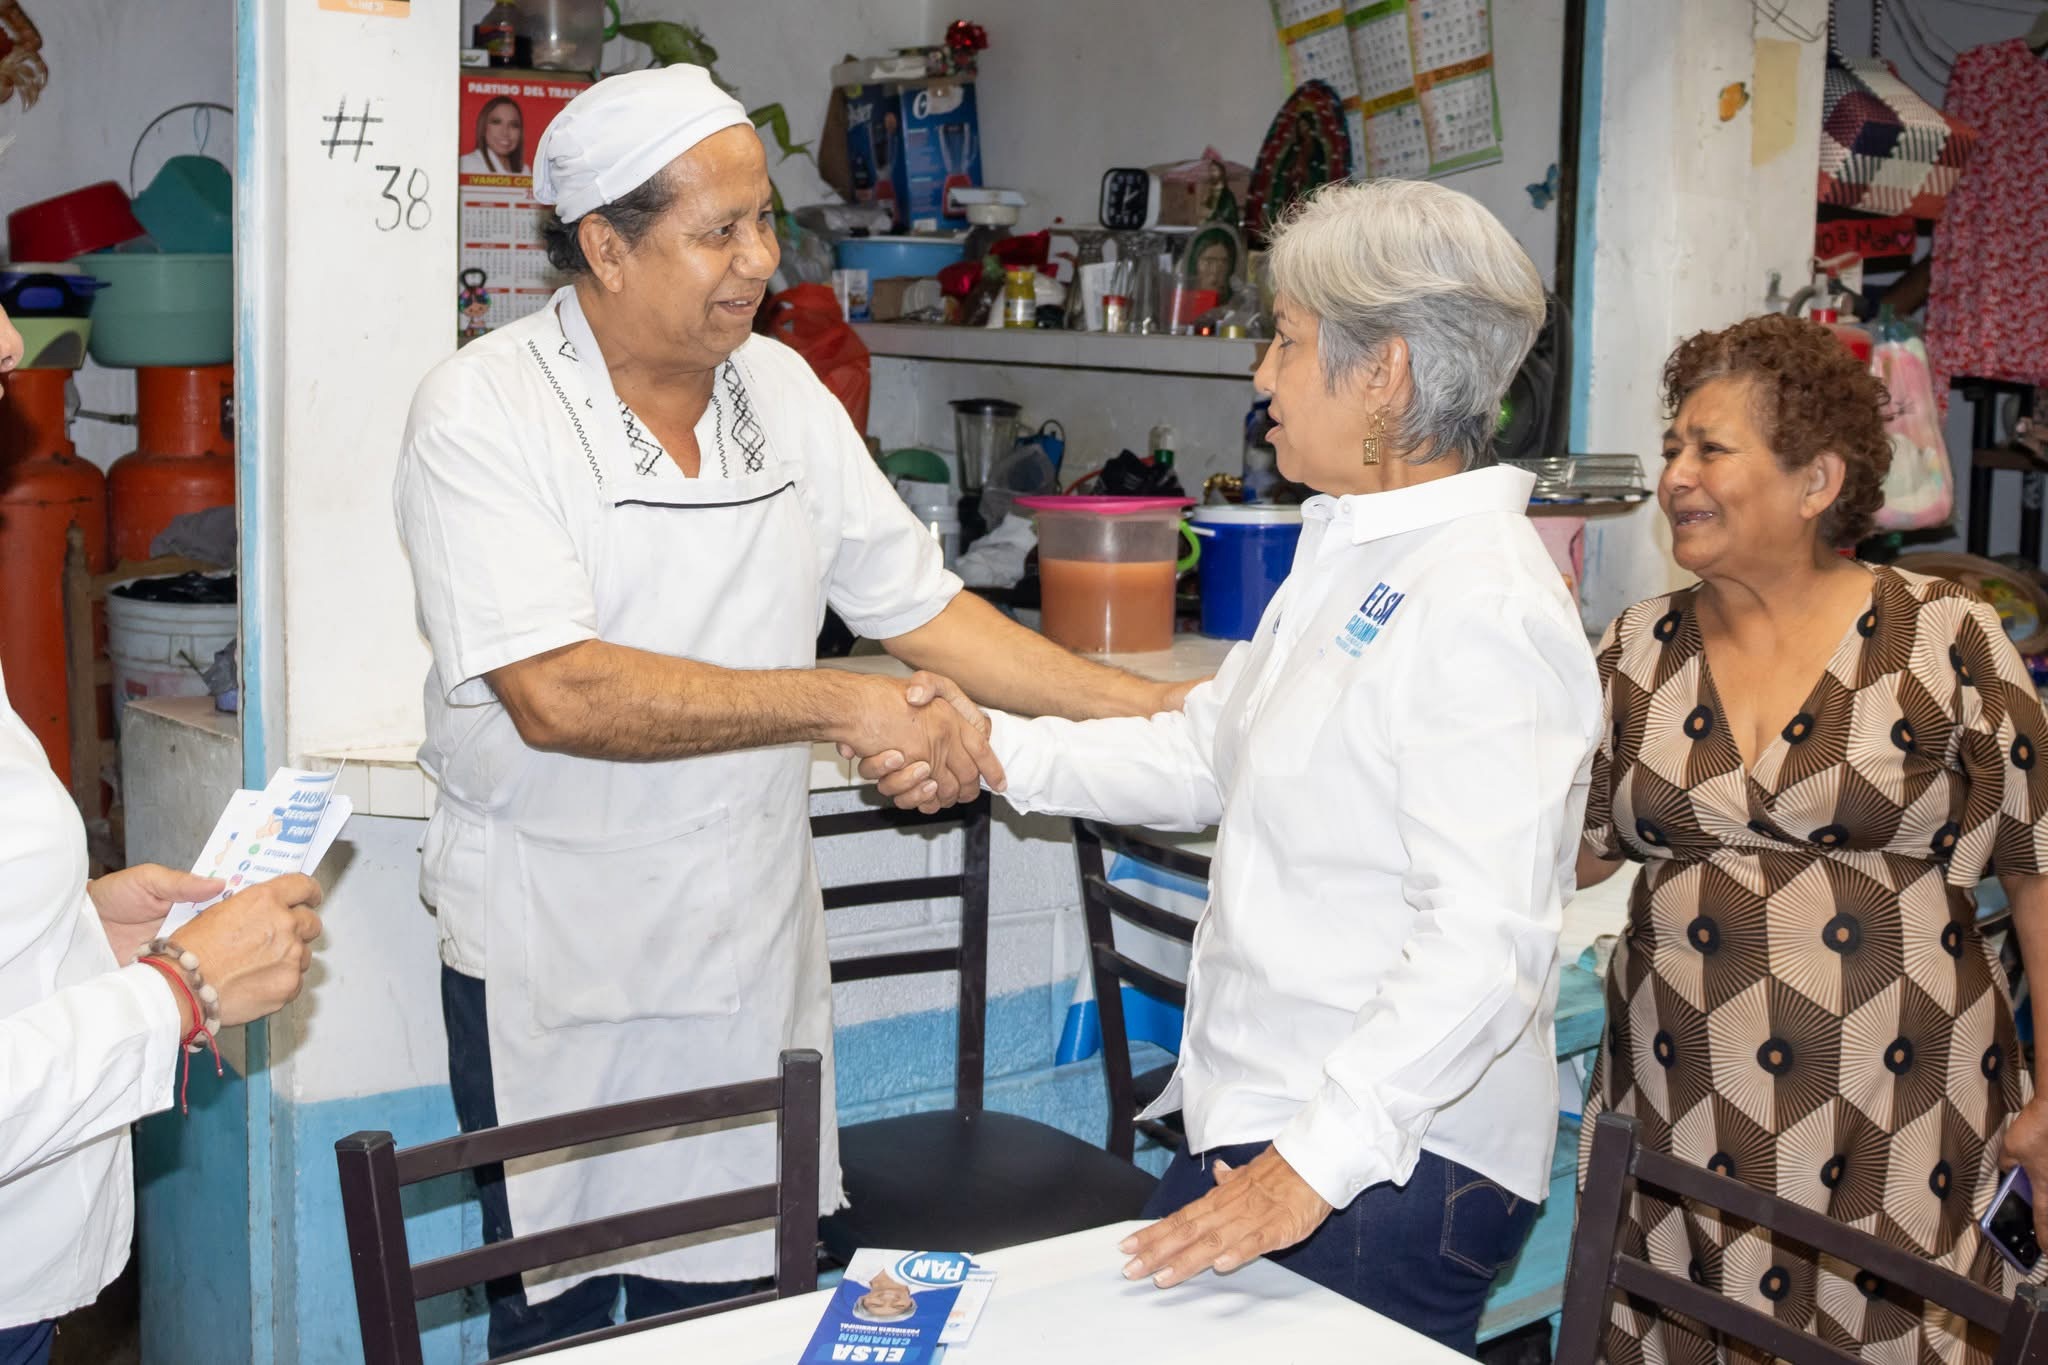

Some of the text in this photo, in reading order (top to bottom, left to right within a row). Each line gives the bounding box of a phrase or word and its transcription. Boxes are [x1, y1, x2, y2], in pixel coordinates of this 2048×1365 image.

[467, 82, 520, 96] PARTIDO
[524, 85, 545, 97] DEL
[375, 164, 432, 231] 38
[1359, 581, 1406, 626] ELSA
[910, 1259, 965, 1281] PAN
[838, 1333, 912, 1345] CARAMÓN
[832, 1344, 906, 1363] ELSA
